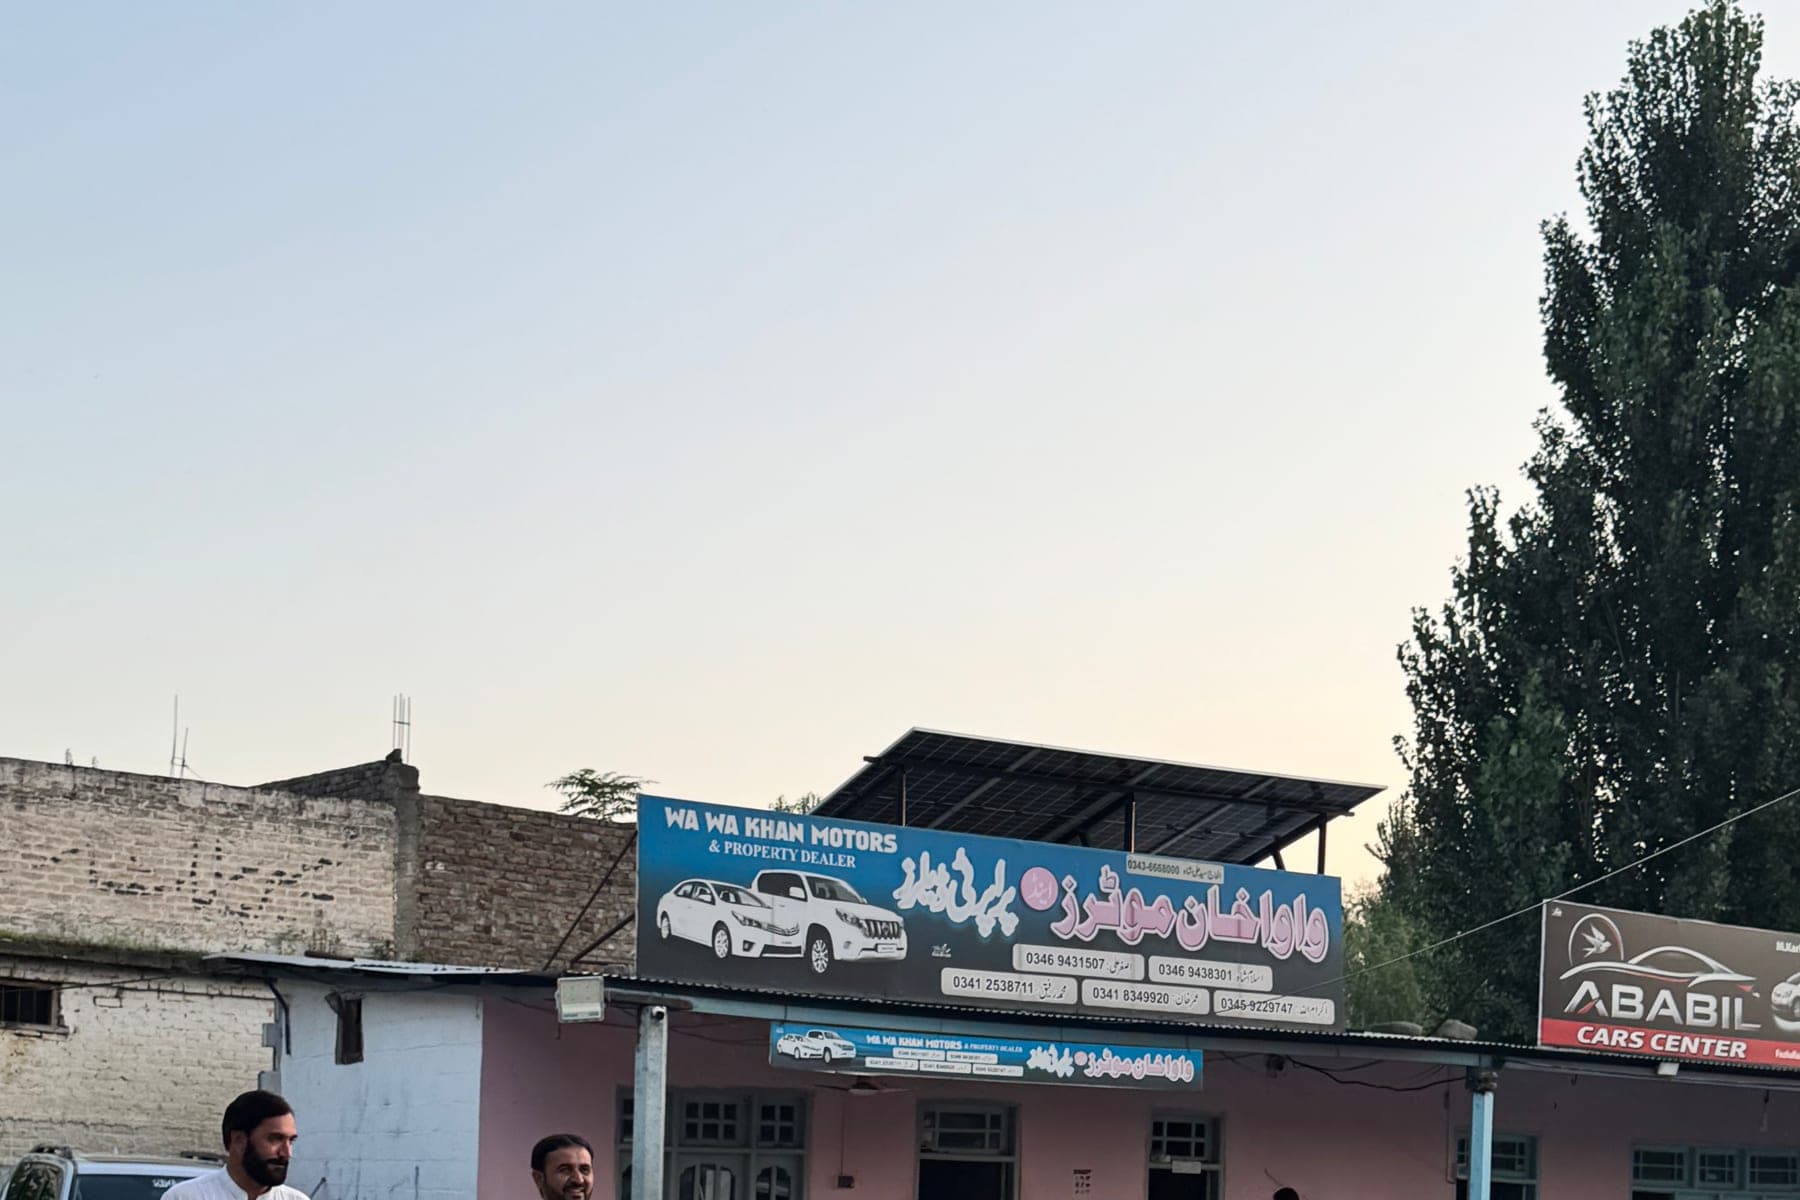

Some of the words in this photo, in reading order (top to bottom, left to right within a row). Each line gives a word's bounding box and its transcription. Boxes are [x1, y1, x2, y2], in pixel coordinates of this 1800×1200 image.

[664, 806, 700, 831] WA
[705, 811, 738, 837] WA
[745, 816, 804, 843] KHAN
[811, 824, 898, 854] MOTORS
[709, 840, 720, 853] &
[724, 841, 800, 863] PROPERTY
[801, 852, 857, 869] DEALER
[1051, 864, 1177, 946] موٹرز
[1026, 952, 1054, 966] 0346
[1058, 954, 1105, 970] 9431507
[1159, 964, 1185, 977] 0346
[1188, 966, 1232, 981] 9438301
[953, 976, 981, 989] 0341
[986, 979, 1033, 993] 2538711
[1093, 987, 1119, 1000] 0341
[1123, 989, 1169, 1004] 8349920
[1221, 998, 1246, 1011] 0345
[1250, 1000, 1293, 1014] 9229747
[1564, 981, 1761, 1031] ABABIL
[926, 1039, 962, 1050] MOTORS
[1577, 1026, 1644, 1049] CARS
[1650, 1034, 1747, 1058] CENTER
